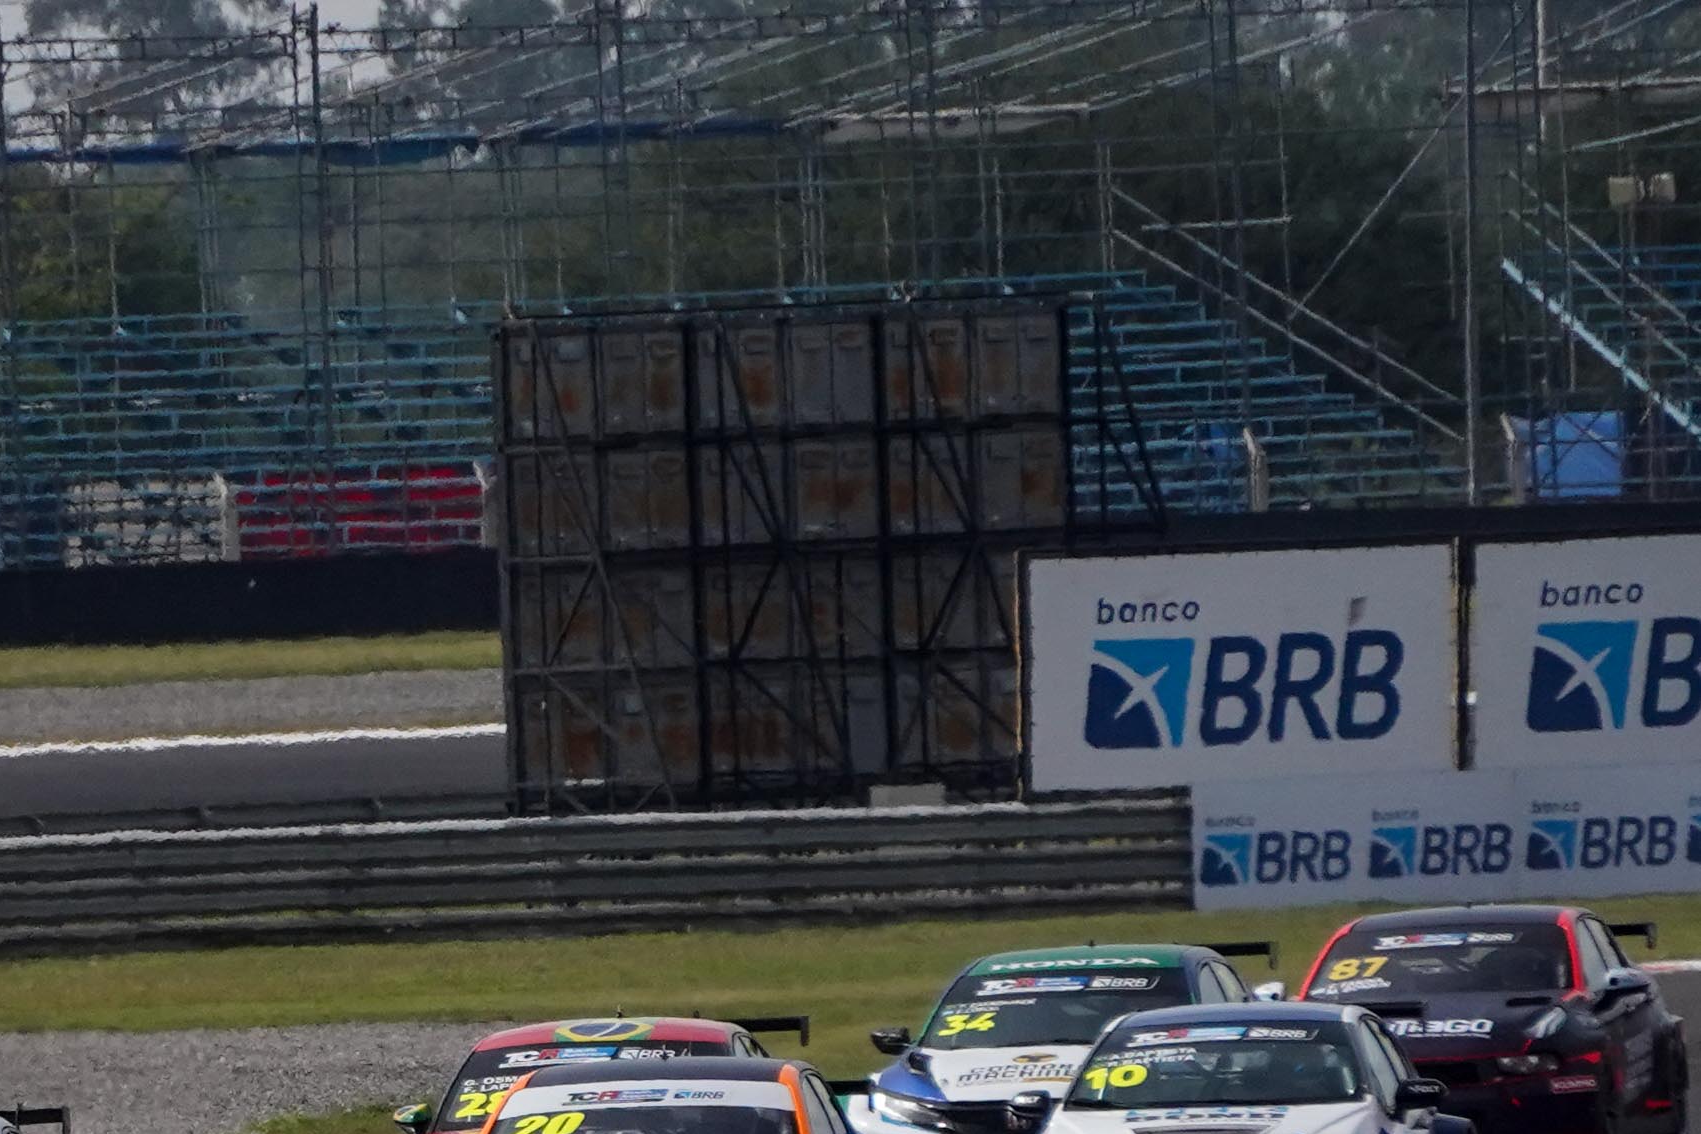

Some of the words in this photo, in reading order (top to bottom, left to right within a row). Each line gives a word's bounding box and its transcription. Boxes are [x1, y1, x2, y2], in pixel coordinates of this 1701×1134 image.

[1540, 580, 1644, 608] banco
[1097, 598, 1200, 625] banco
[1200, 629, 1404, 746] BRB
[1420, 823, 1513, 876] BRB
[1580, 815, 1677, 869] BRB
[1255, 830, 1352, 884] BRB
[991, 957, 1159, 971] HONDA
[1329, 956, 1389, 981] 87
[1111, 978, 1148, 988] BRB
[938, 1012, 997, 1036] 34
[483, 1076, 519, 1086] OSM
[1085, 1064, 1148, 1090] 10
[691, 1090, 724, 1100] BRB
